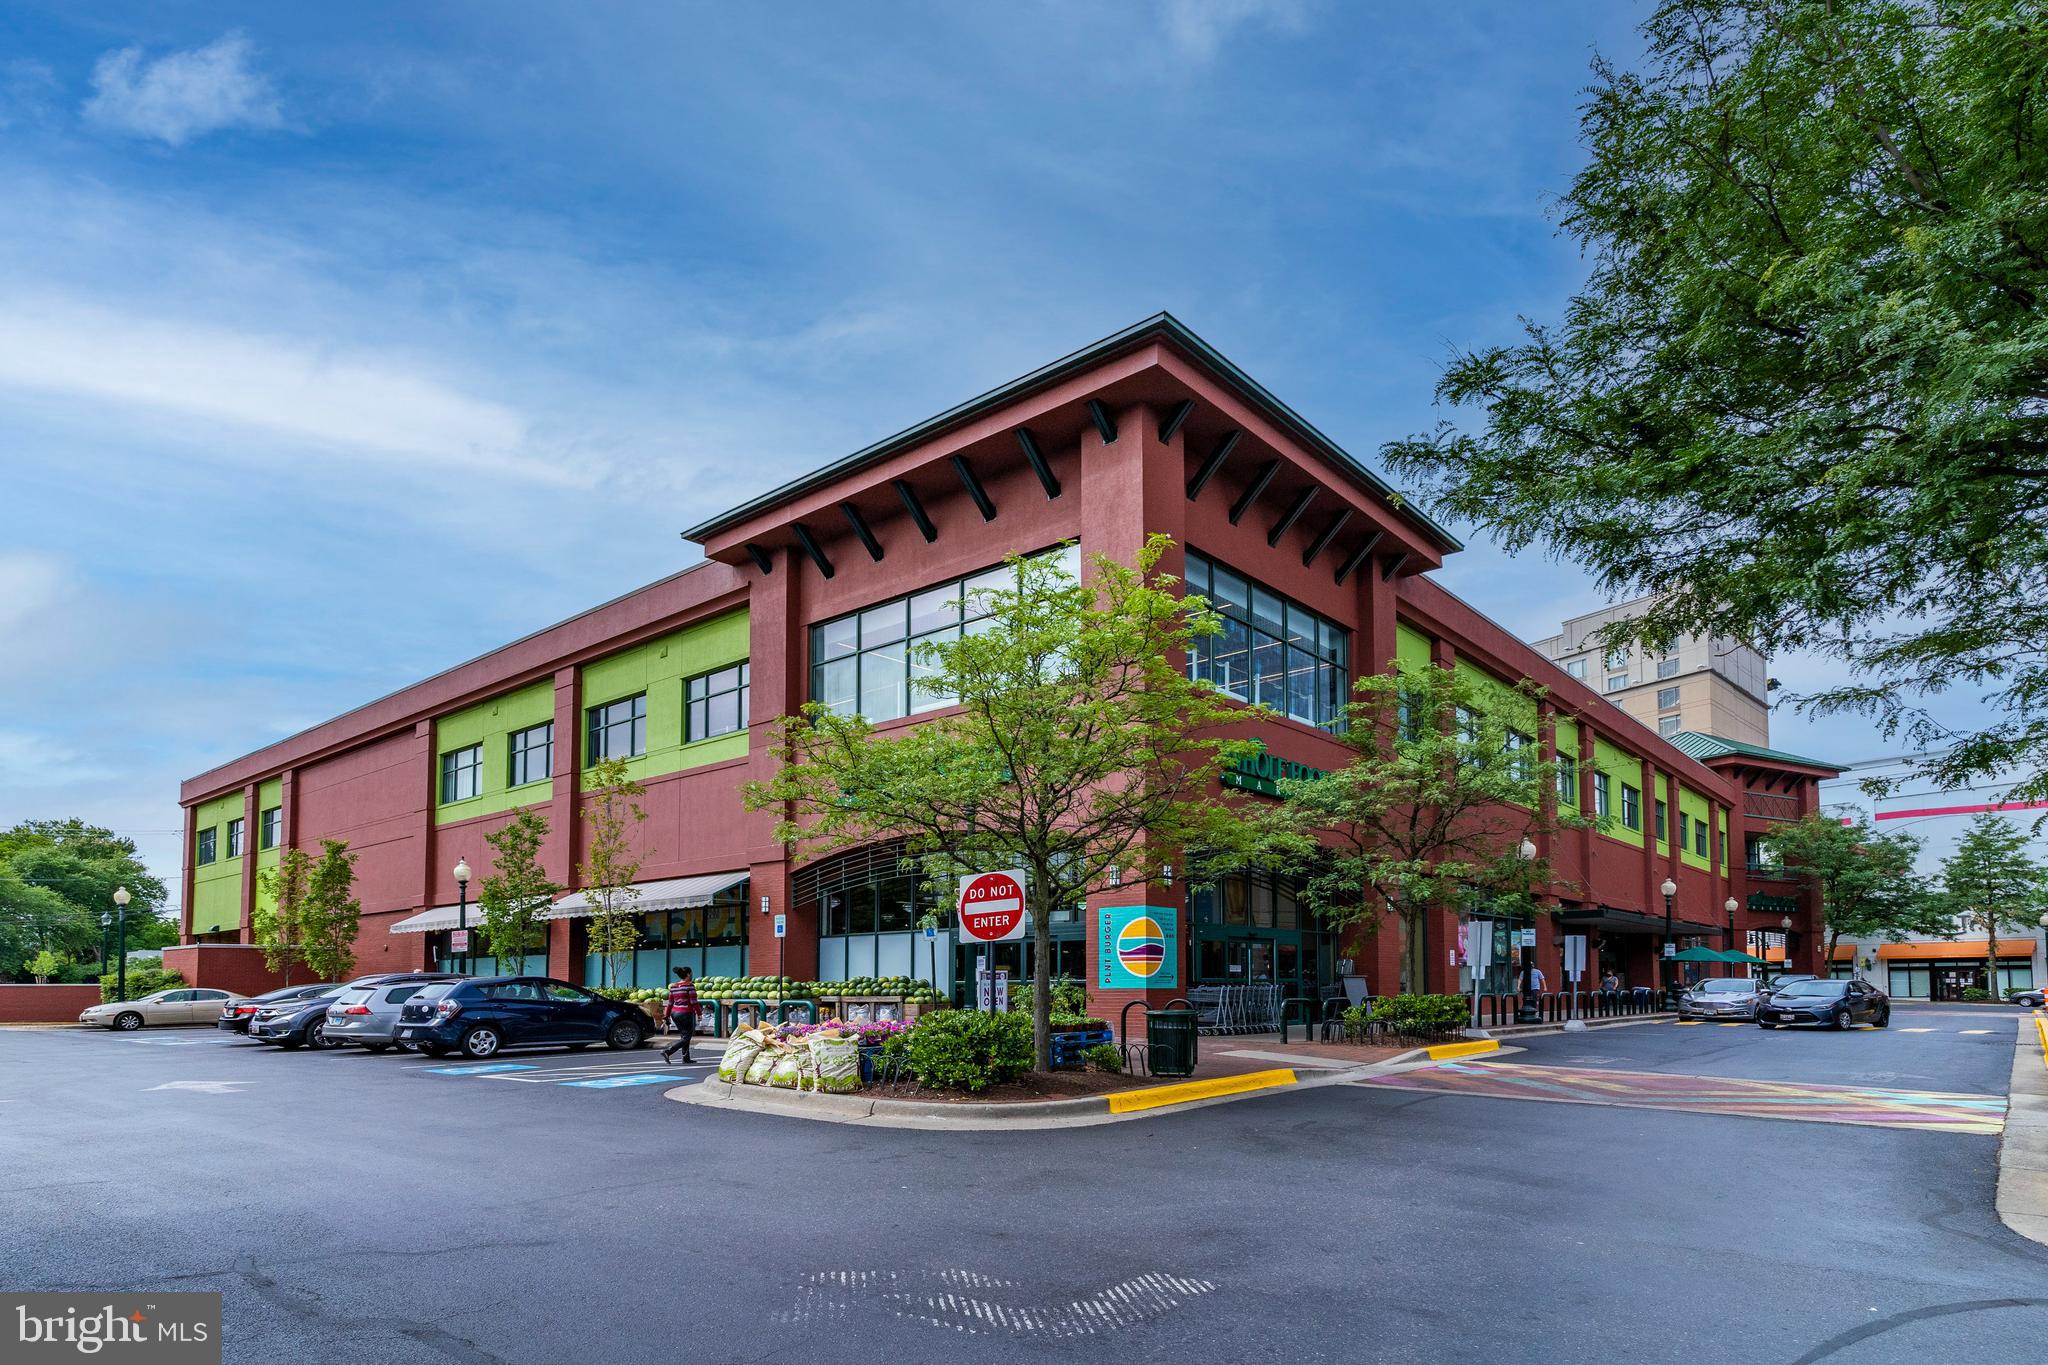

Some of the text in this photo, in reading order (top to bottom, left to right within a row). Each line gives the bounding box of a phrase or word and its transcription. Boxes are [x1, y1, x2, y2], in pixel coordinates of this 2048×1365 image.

[970, 884, 1014, 900] DO NOT
[974, 915, 1010, 929] ENTER
[1104, 913, 1112, 984] PLNT BURGER
[983, 987, 1004, 997] NW
[983, 996, 1004, 1007] OEN
